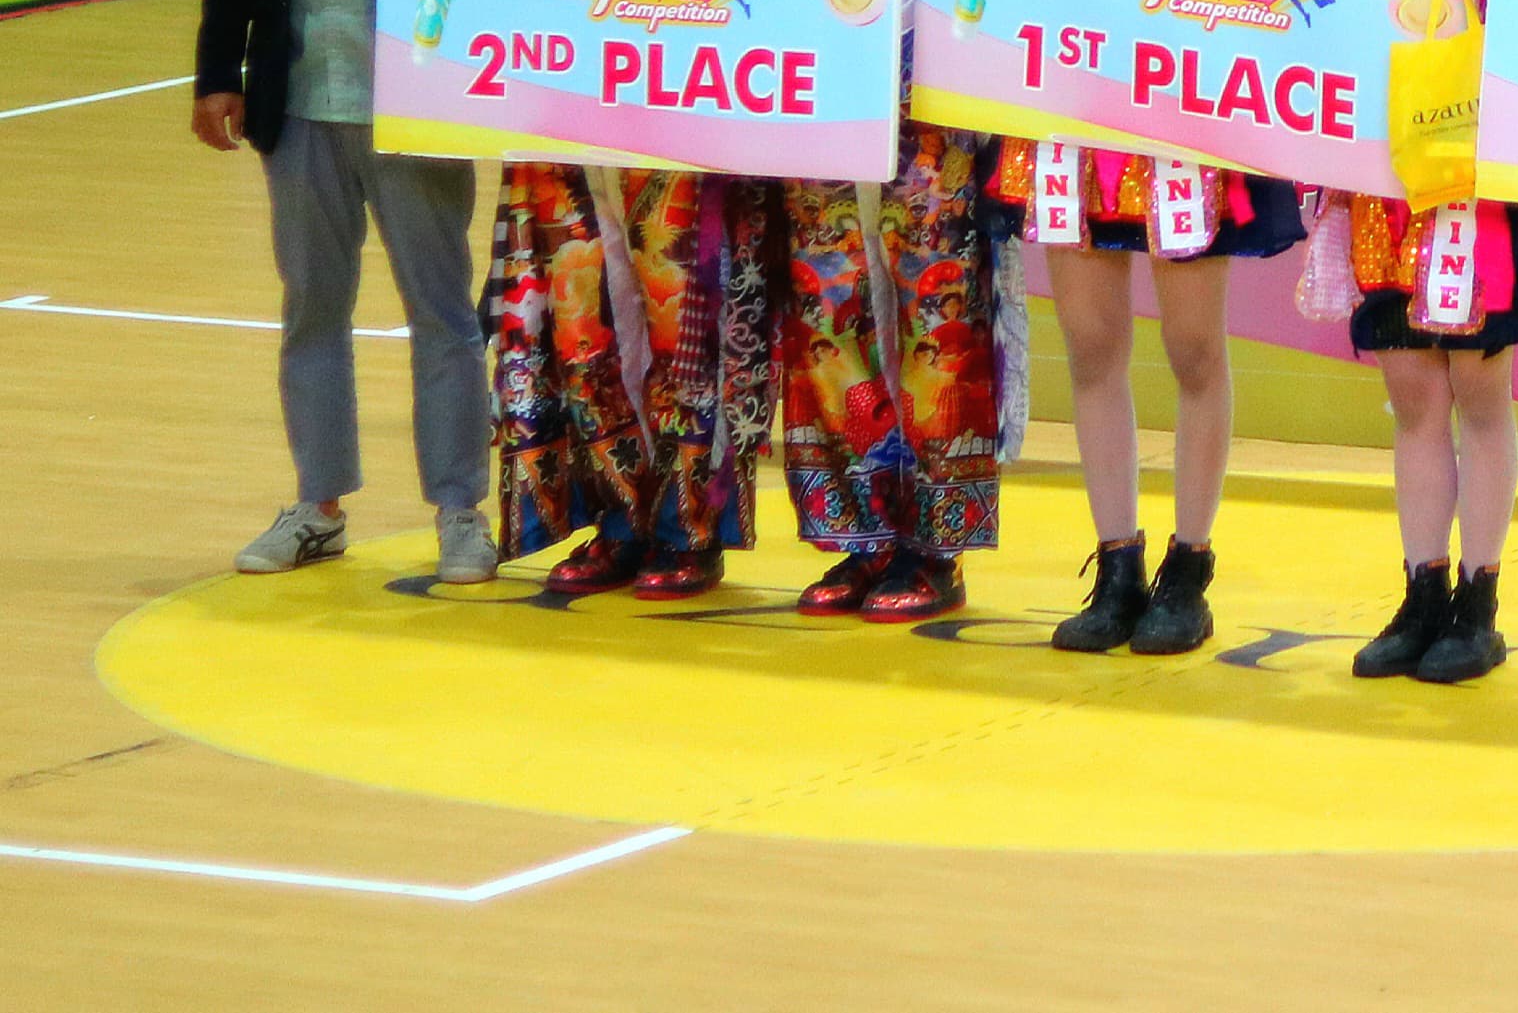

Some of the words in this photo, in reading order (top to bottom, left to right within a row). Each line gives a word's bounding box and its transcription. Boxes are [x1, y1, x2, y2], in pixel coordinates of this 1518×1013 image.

[612, 0, 730, 33] Competition
[464, 32, 575, 98] 2ND
[599, 39, 817, 117] PLACE
[1016, 23, 1107, 90] 1ST
[1131, 41, 1357, 142] PLACE
